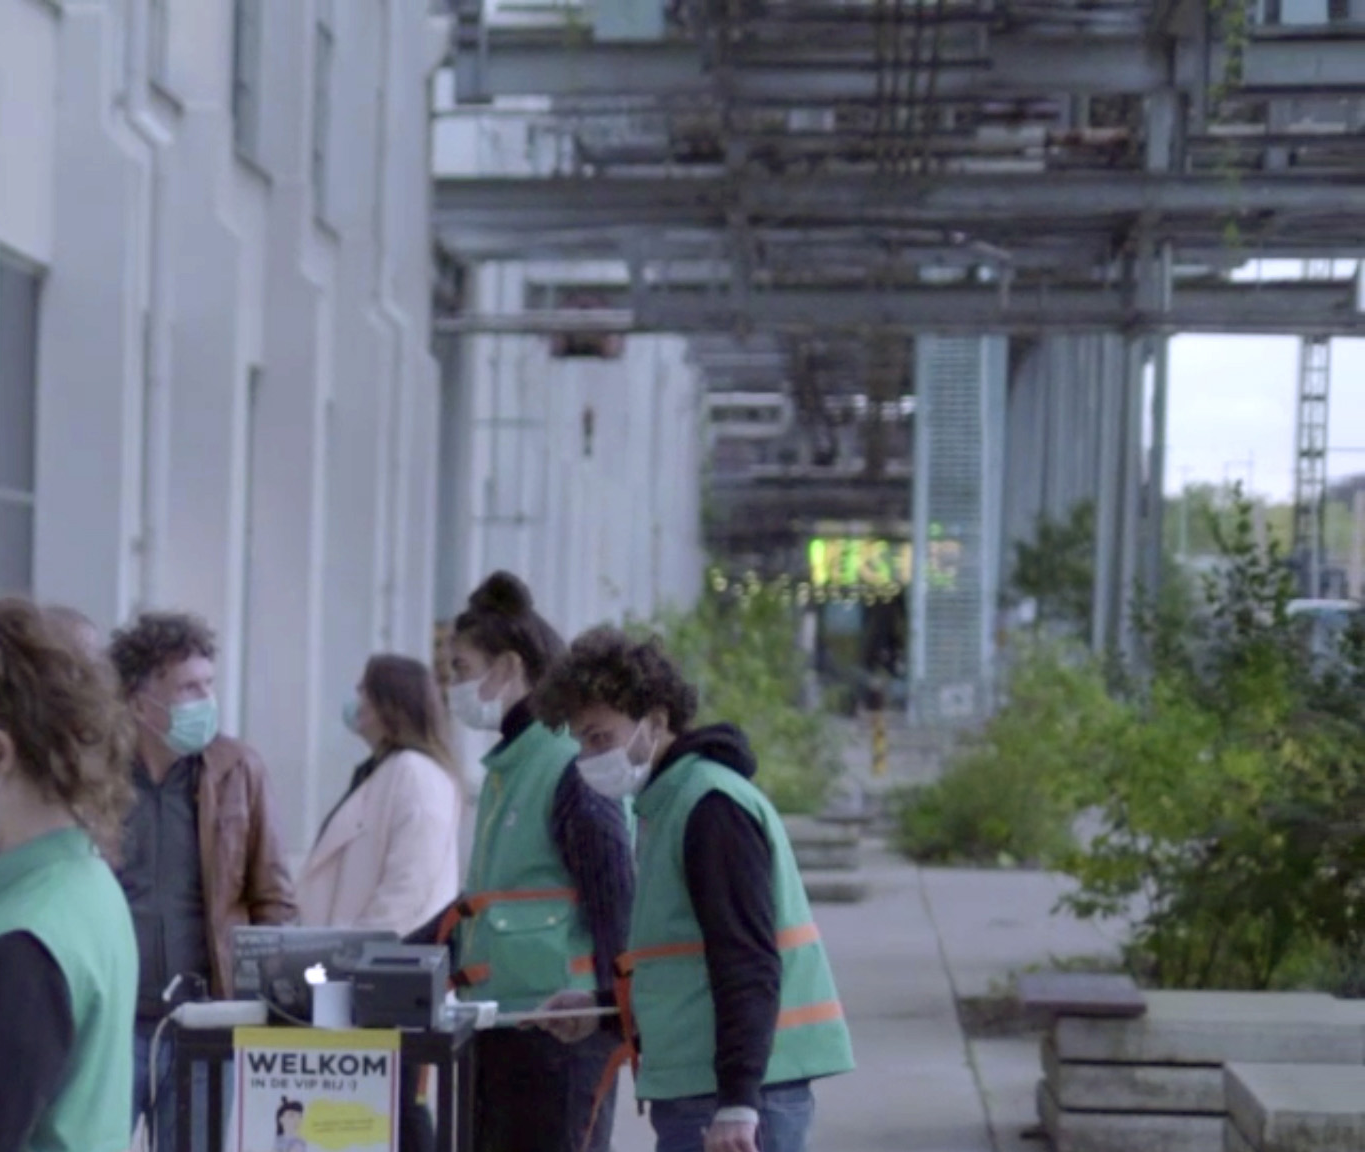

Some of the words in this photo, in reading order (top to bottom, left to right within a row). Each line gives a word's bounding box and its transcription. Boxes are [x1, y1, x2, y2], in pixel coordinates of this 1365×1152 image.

[248, 1052, 387, 1077] WELKOM
[251, 1078, 266, 1089] IN
[270, 1079, 289, 1089] DE
[295, 1080, 318, 1090] VIP
